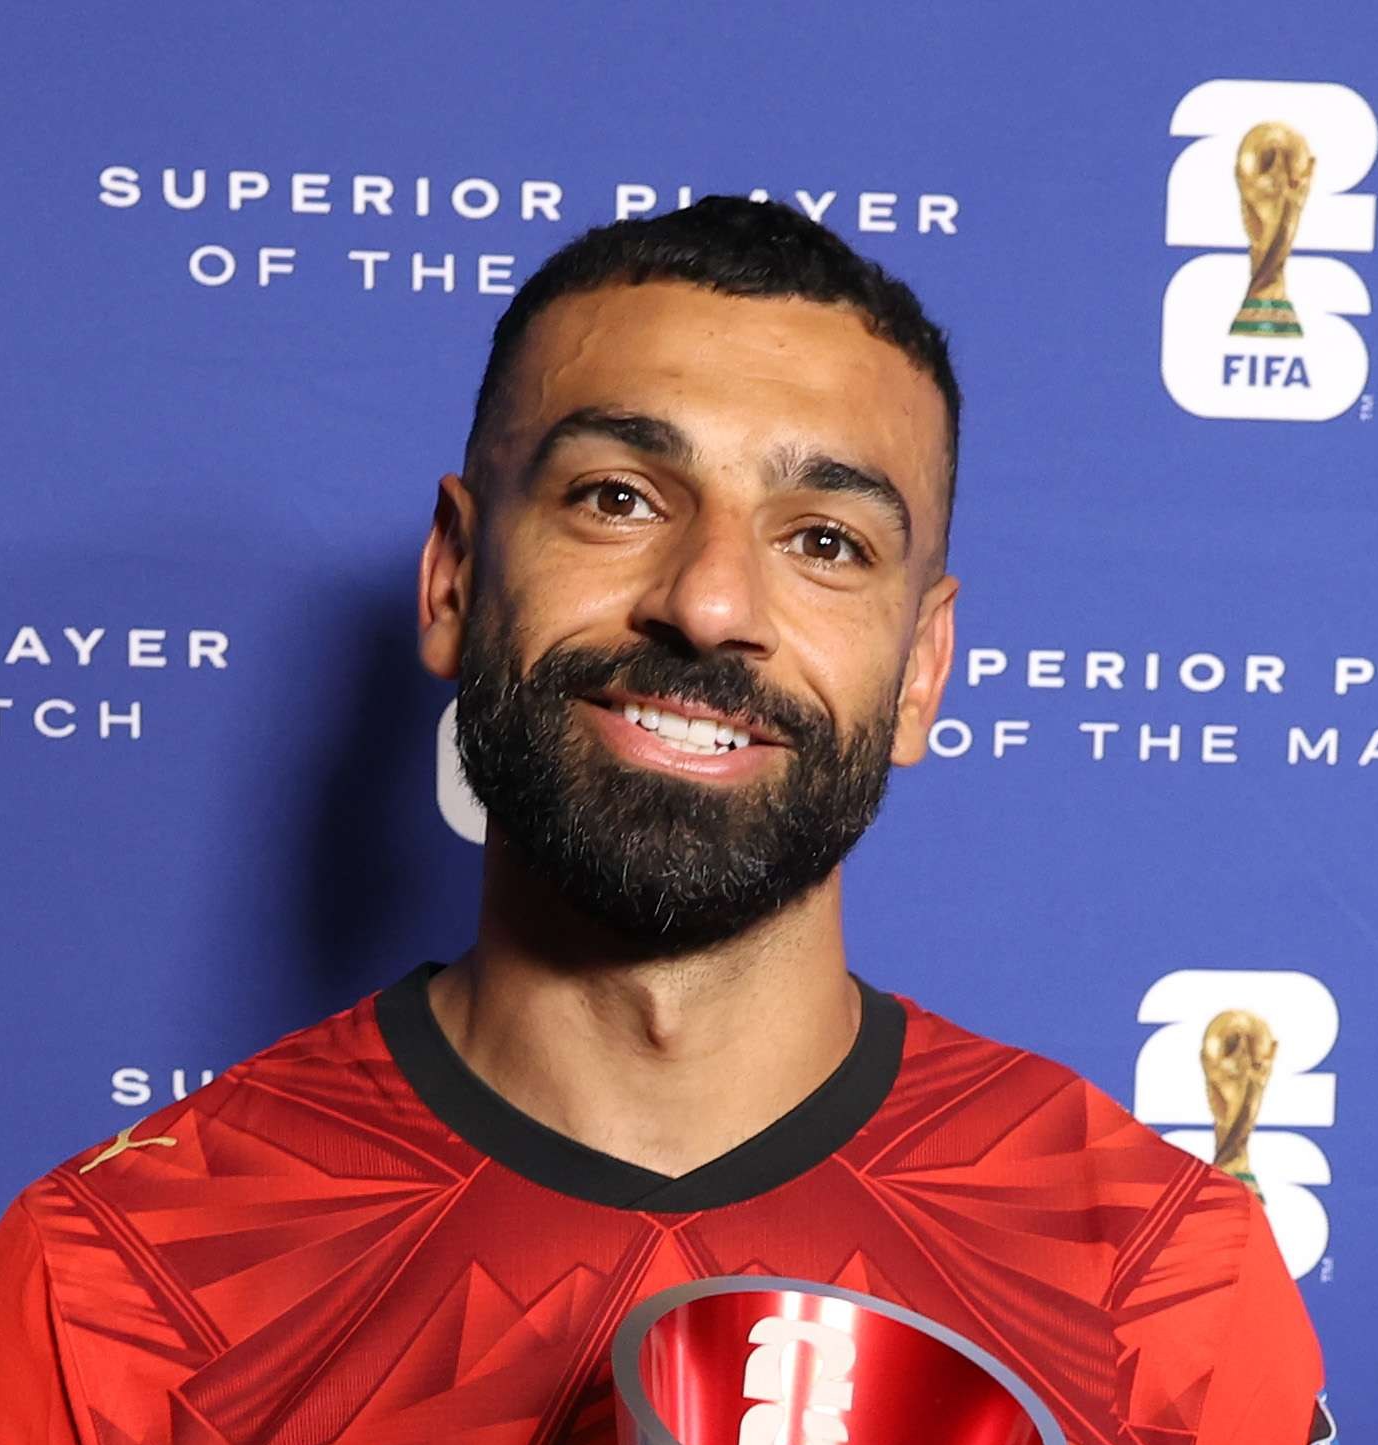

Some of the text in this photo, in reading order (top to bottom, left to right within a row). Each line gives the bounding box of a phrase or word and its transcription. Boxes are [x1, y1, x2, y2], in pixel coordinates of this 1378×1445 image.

[98, 165, 960, 236] SUPERIOR PYER
[188, 244, 516, 295] OF THE
[1222, 353, 1311, 389] FIFA
[967, 648, 1286, 694] PERIOR
[927, 718, 1031, 759] OF
[1078, 722, 1238, 764] THE
